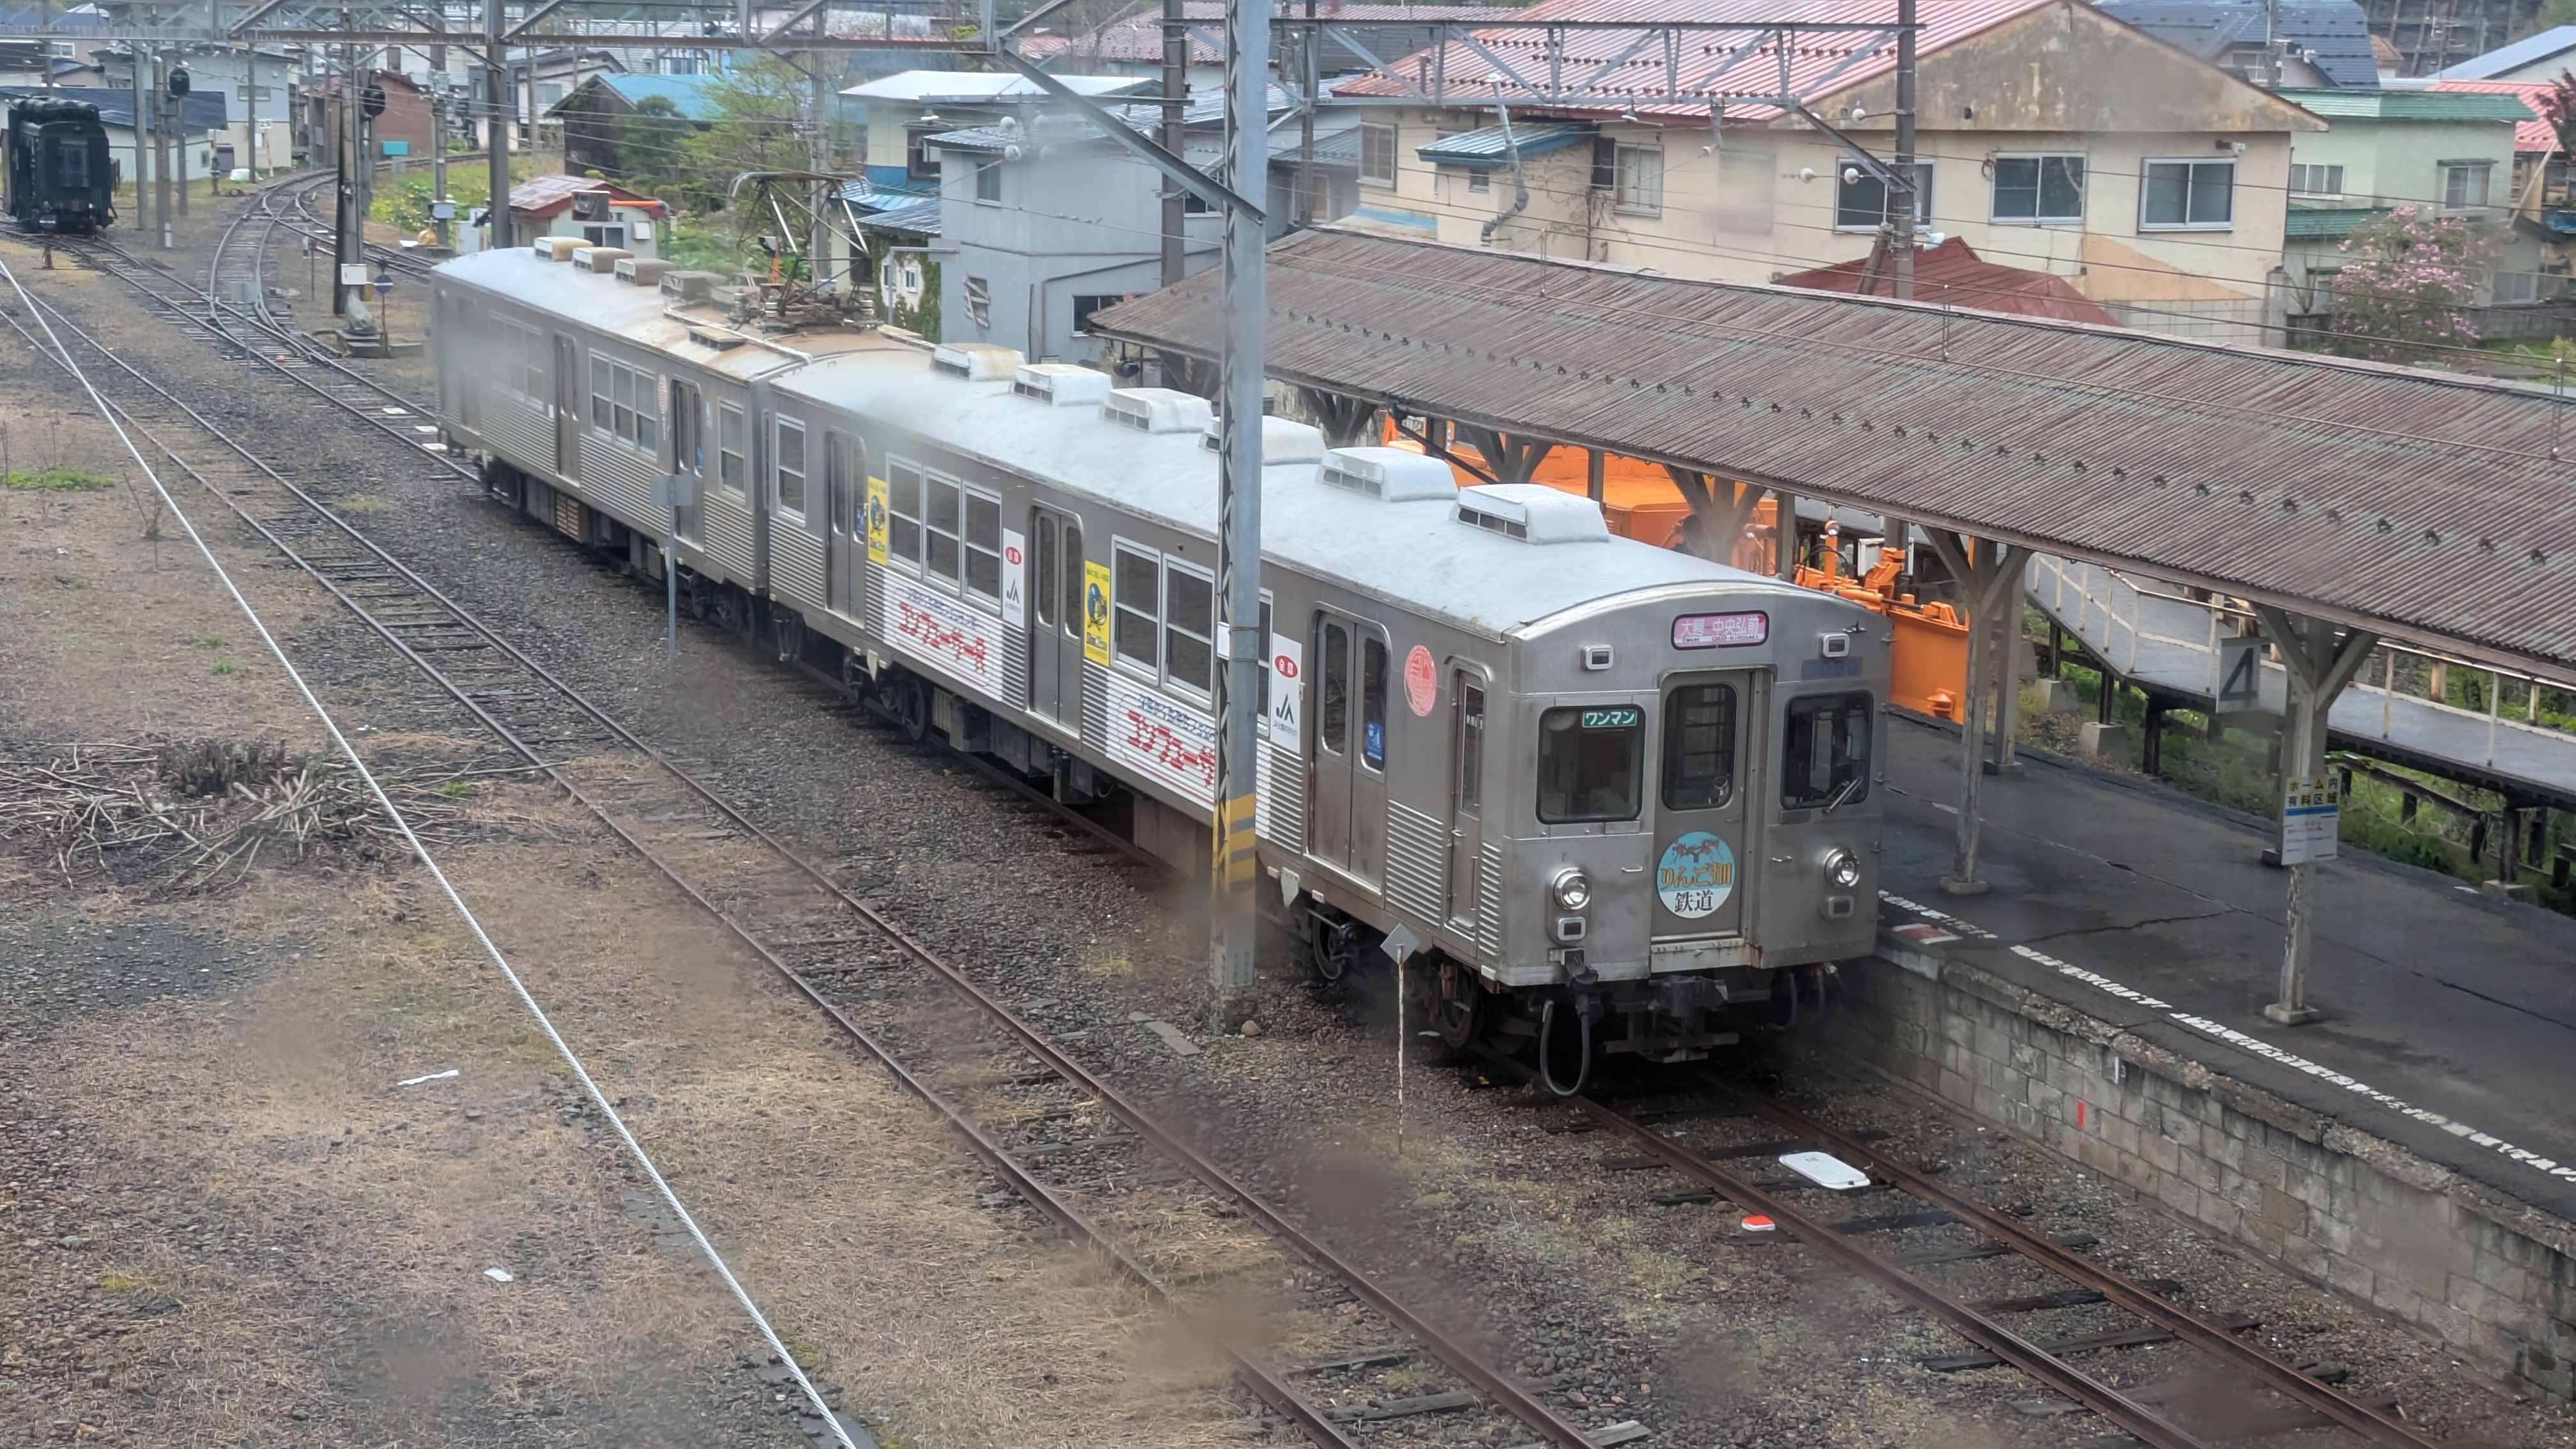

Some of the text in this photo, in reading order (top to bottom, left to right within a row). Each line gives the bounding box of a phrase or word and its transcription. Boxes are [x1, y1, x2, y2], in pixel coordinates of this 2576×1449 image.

[1006, 579, 1019, 603] JA
[2220, 647, 2259, 707] 4
[1276, 694, 1294, 724] JA
[1586, 711, 1635, 725] ワンマン
[2289, 777, 2338, 792] ホーム内
[2287, 792, 2338, 807] 有料区域
[1660, 862, 1732, 890] りんご畑
[1675, 890, 1713, 912] 鉄道
